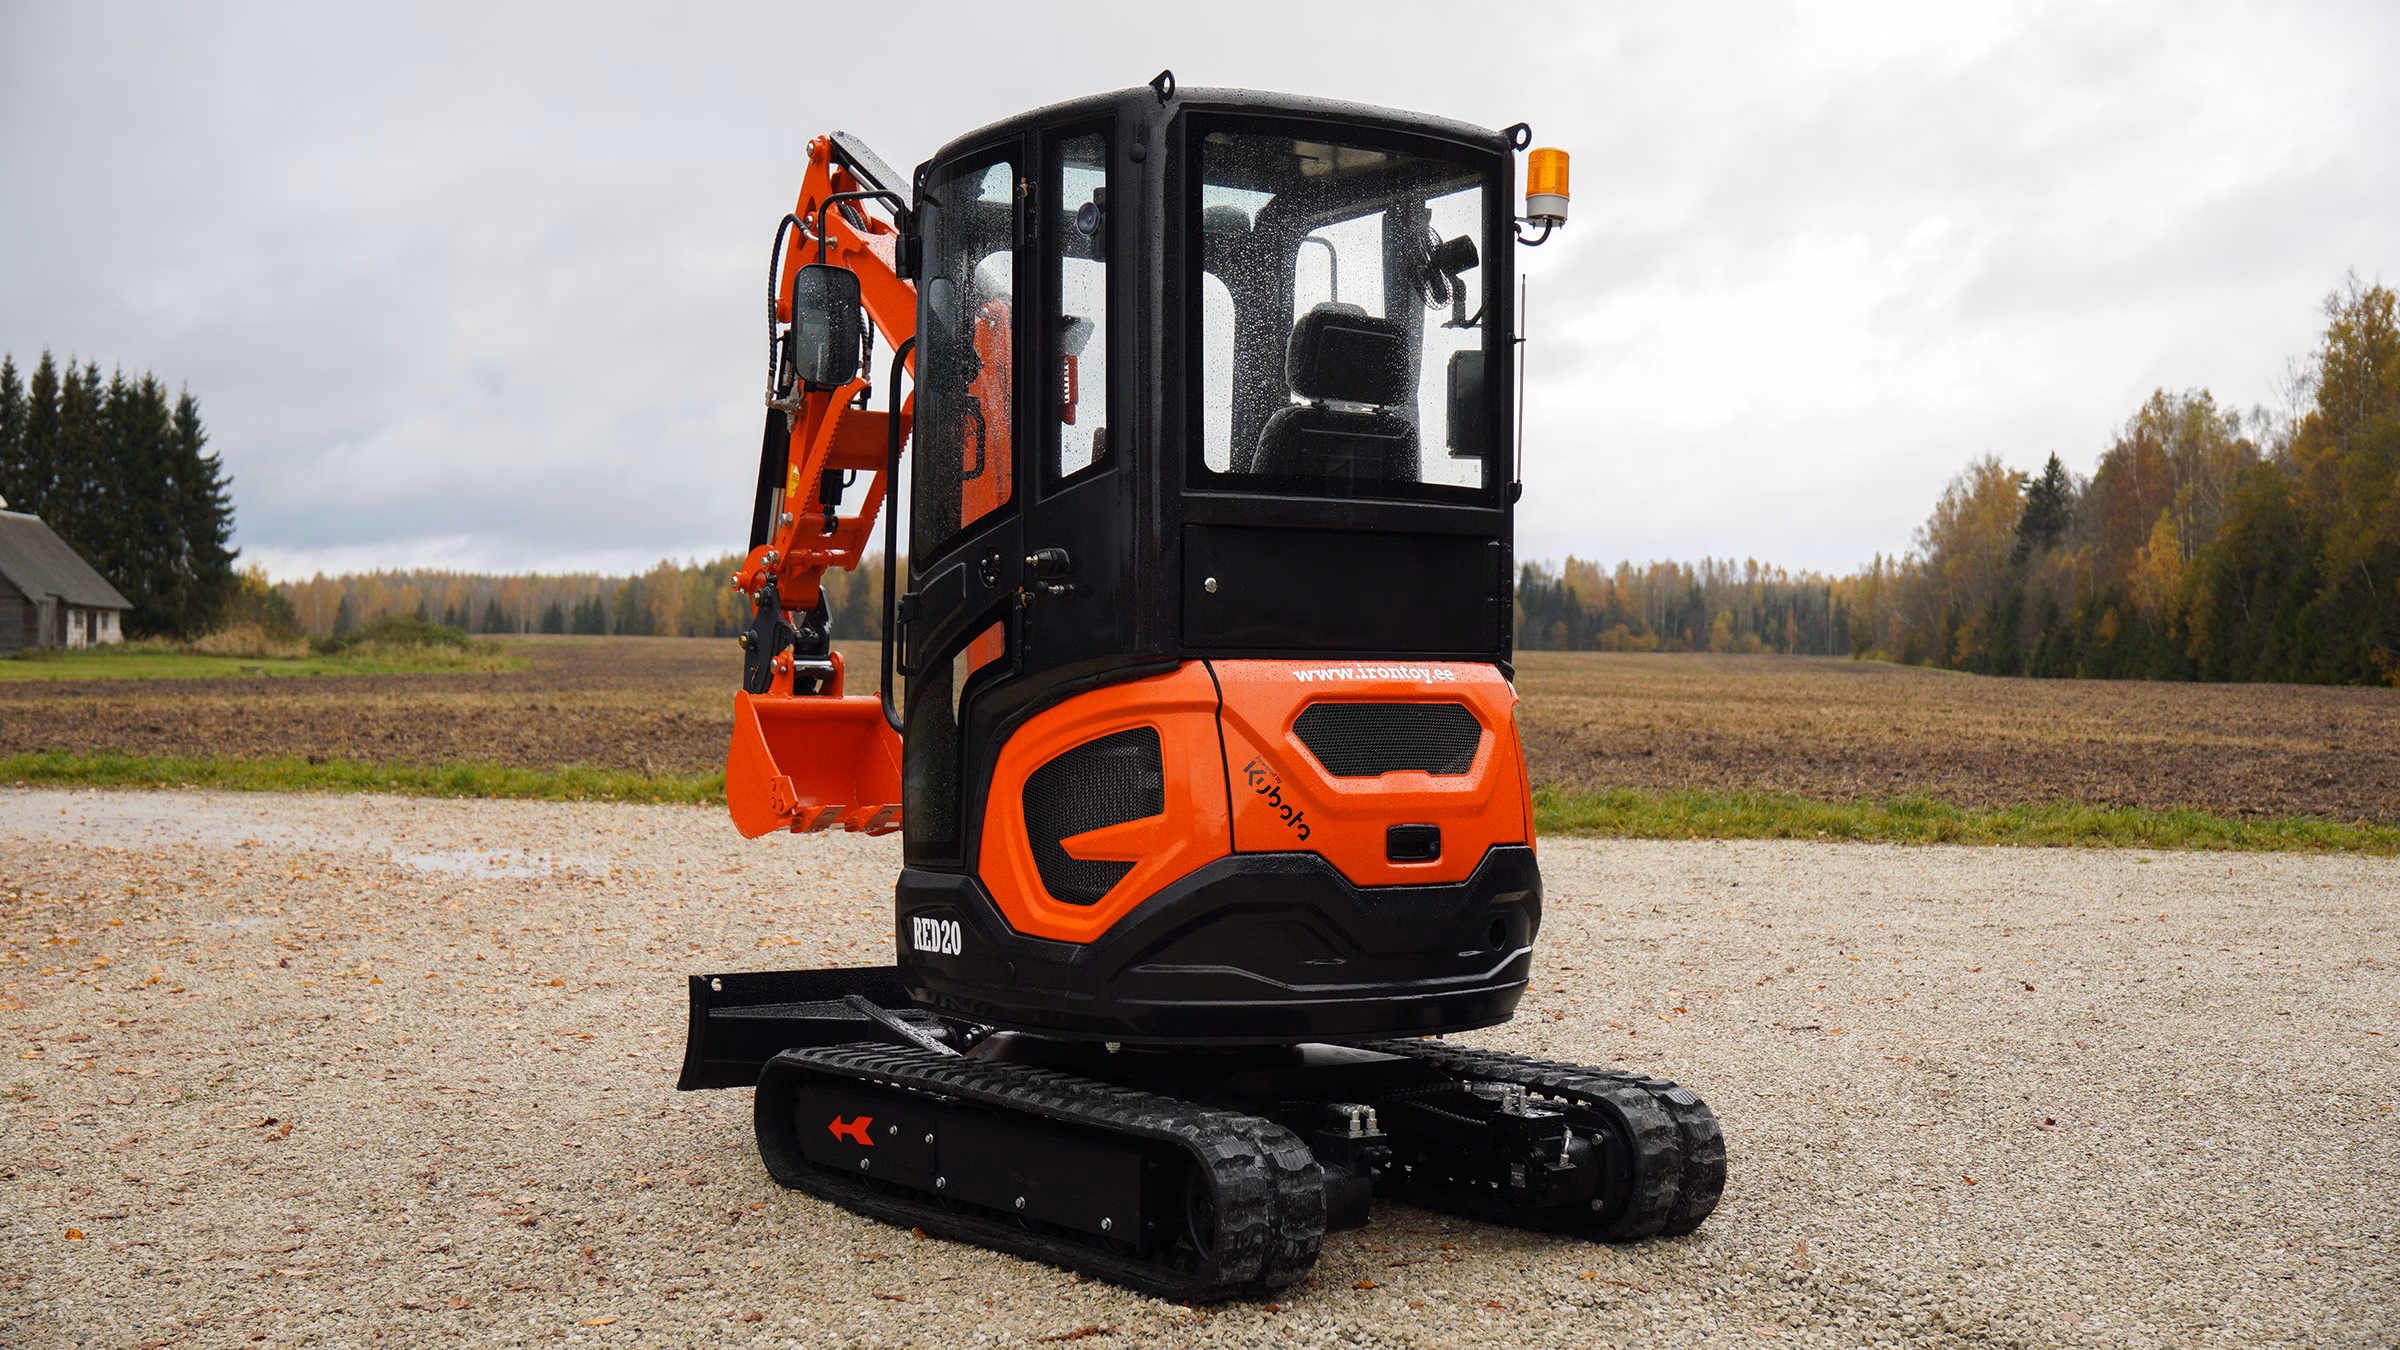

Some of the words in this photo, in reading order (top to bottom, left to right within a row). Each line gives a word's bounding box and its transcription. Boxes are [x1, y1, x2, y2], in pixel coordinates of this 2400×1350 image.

[1292, 664, 1456, 684] www.irontoy.ee
[1243, 760, 1311, 842] Kubota
[912, 916, 962, 956] RED20
